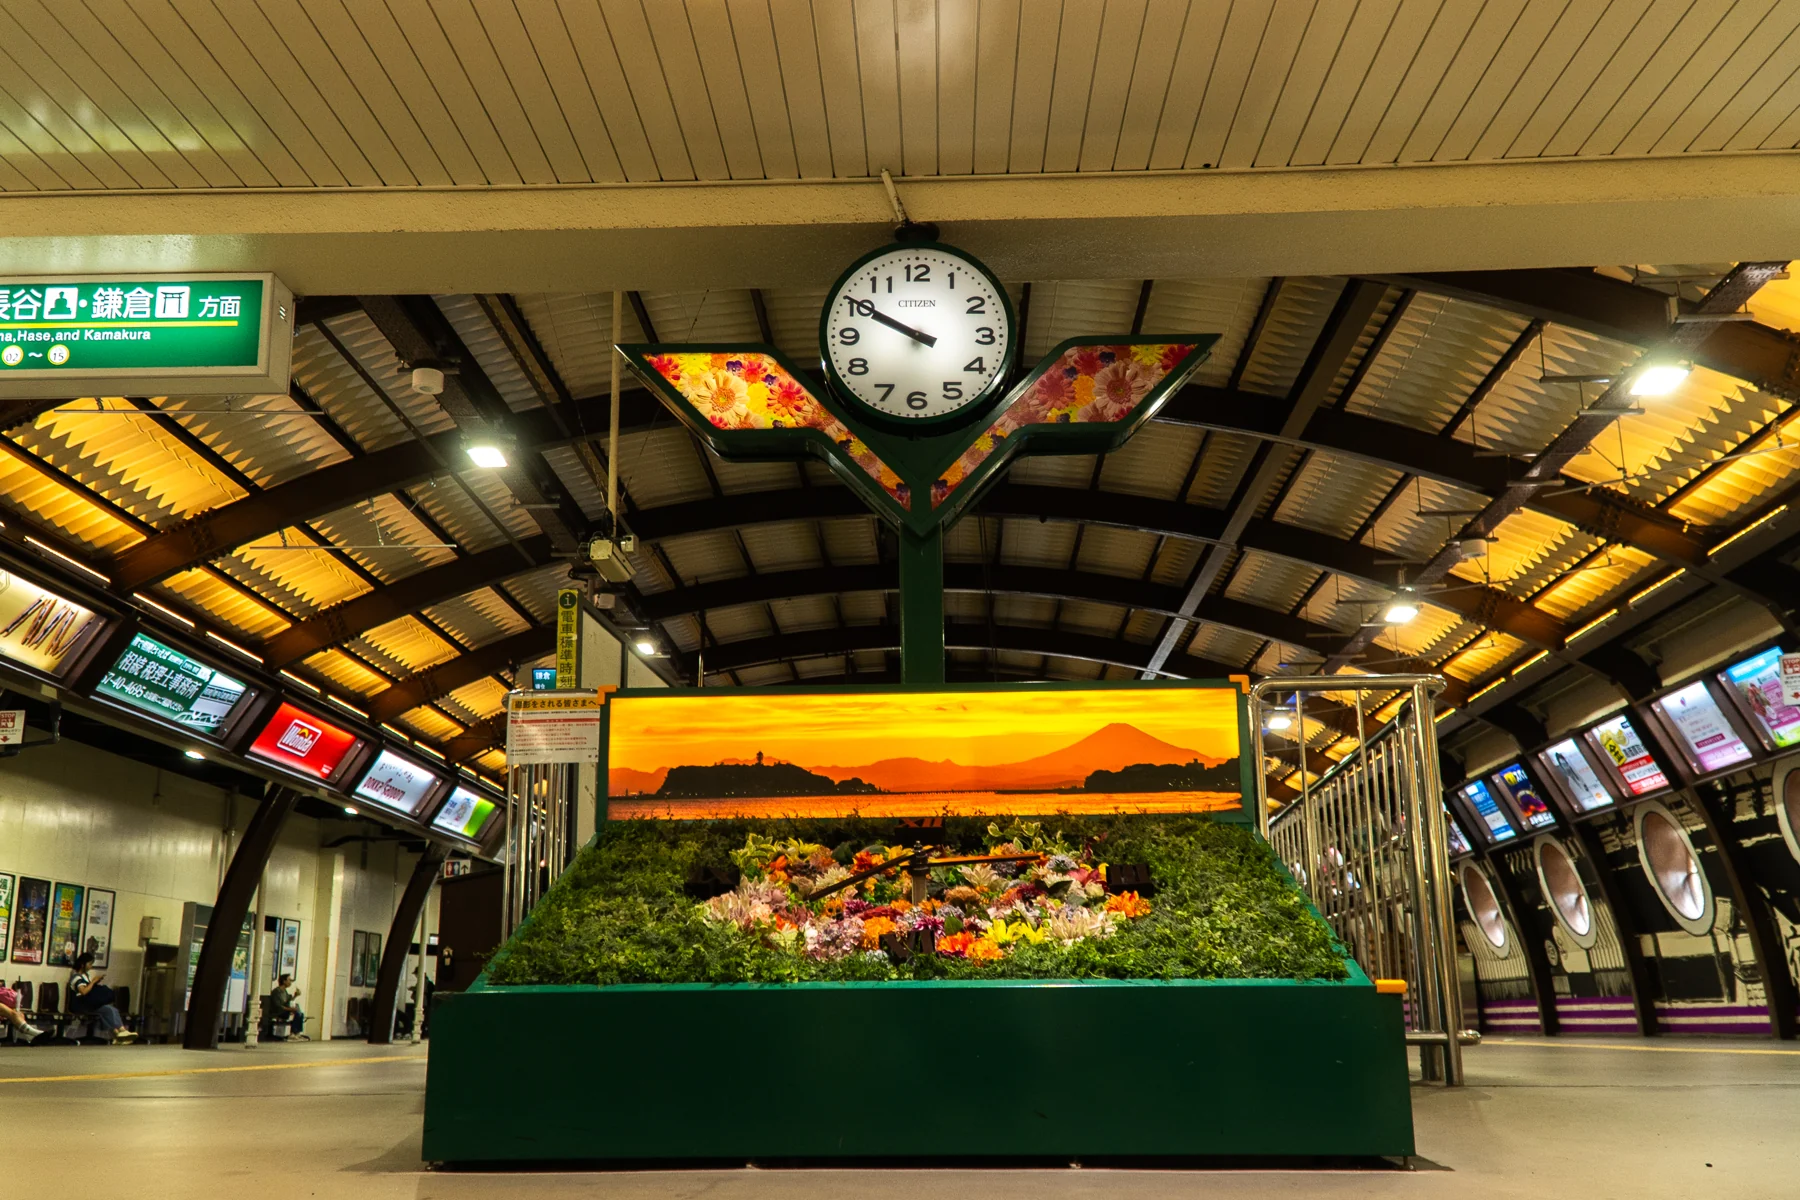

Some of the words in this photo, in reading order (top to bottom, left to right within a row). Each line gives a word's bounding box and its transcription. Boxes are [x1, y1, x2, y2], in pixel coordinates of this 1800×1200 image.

[904, 263, 931, 282] 12
[947, 271, 955, 289] 1
[869, 276, 893, 293] 11
[198, 295, 241, 318] 方面
[847, 299, 876, 317] 10
[898, 299, 936, 308] CITIZEN
[965, 296, 986, 314] 2
[84, 328, 151, 341] Kamakura
[839, 327, 860, 346] 9
[975, 326, 996, 345] 3
[847, 357, 869, 376] 8
[963, 356, 987, 375] 4
[874, 383, 895, 402] 7
[942, 381, 963, 400] 5
[906, 391, 928, 411] 6
[282, 725, 313, 752] Wonda
